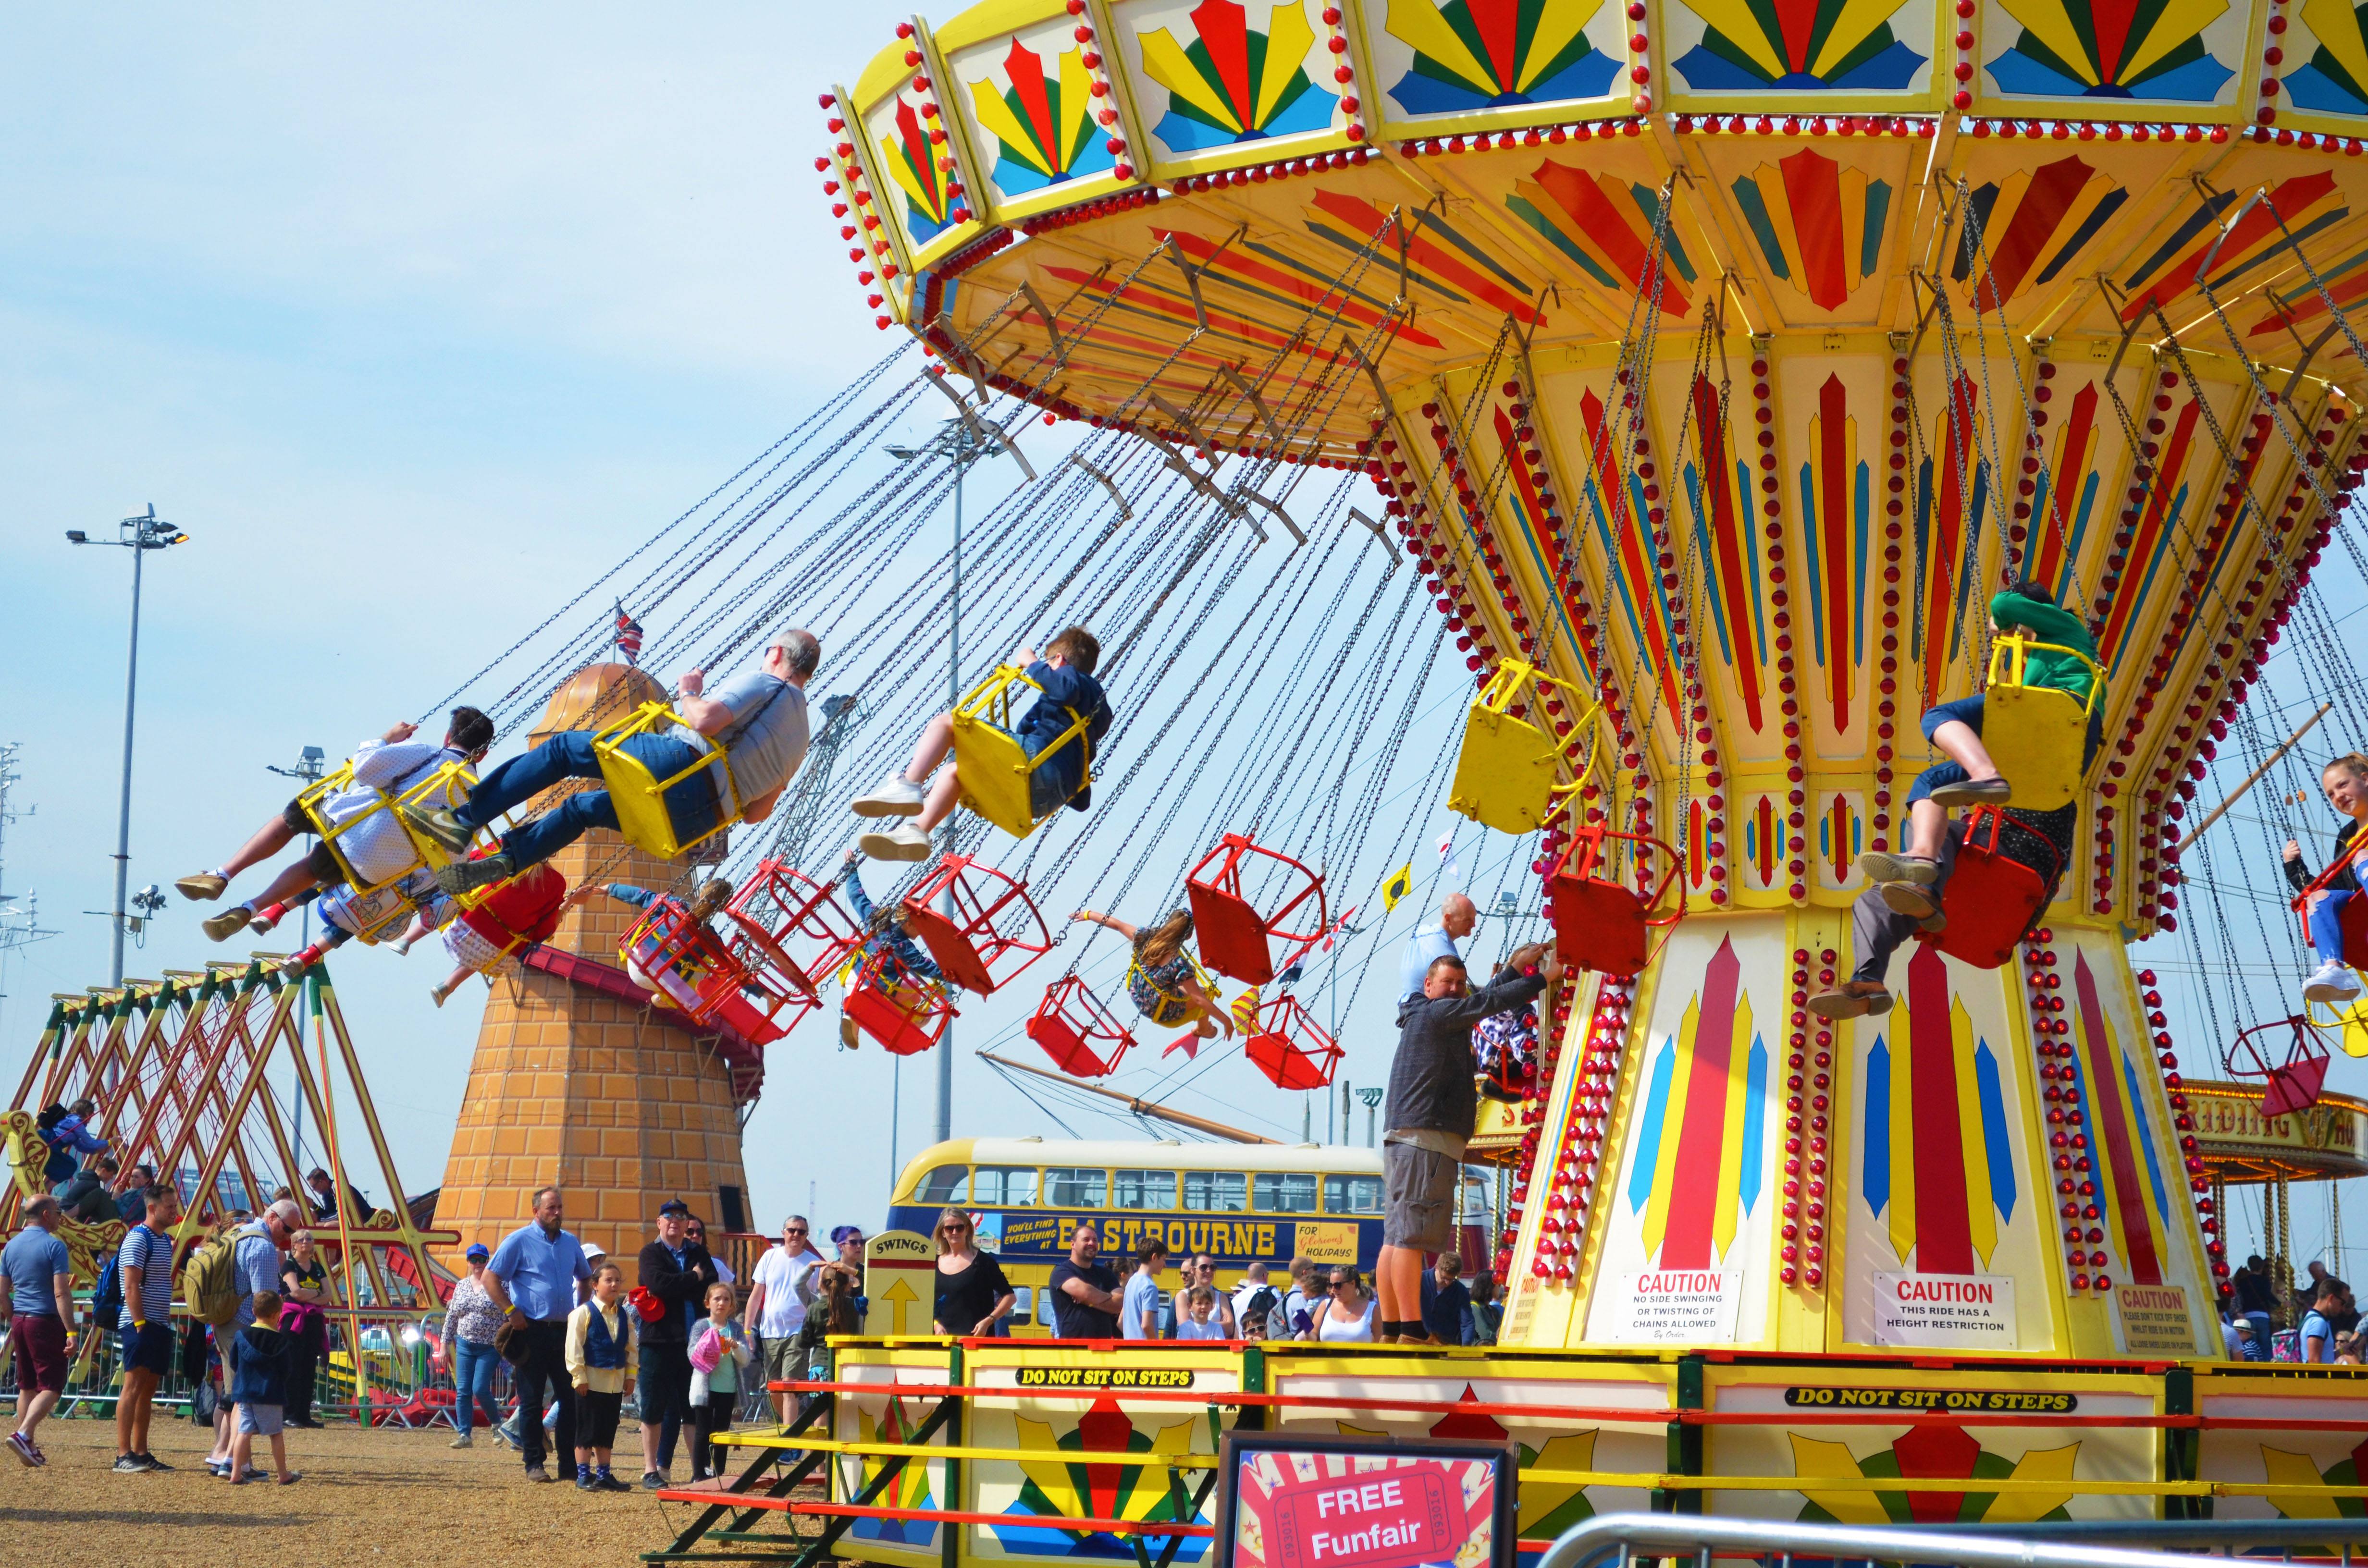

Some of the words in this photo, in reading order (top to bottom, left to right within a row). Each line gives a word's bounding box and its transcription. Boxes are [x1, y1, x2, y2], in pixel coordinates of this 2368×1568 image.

[1007, 1222, 1033, 1234] YOU'LL
[1035, 1219, 1055, 1229] FIND
[1299, 1226, 1318, 1235] FOR
[1004, 1229, 1057, 1245] EVERYTHING
[1297, 1233, 1343, 1251] Glorious
[876, 1238, 928, 1254] SWINGS
[1040, 1240, 1051, 1250] AT
[1306, 1248, 1352, 1257] HOLIDAYS
[1638, 1274, 1721, 1293] CAUTION
[1898, 1280, 1993, 1303] CAUTION
[2122, 1290, 2183, 1310] CAUTION
[1900, 1306, 1925, 1314] THIS
[1929, 1307, 1954, 1315] RIDE
[2123, 1311, 2140, 1320] PLEASE
[2140, 1312, 2153, 1321] DON'T
[2154, 1313, 2164, 1321] KICK
[2165, 1313, 2173, 1322] OFF
[2173, 1314, 2188, 1323] SHOES
[1887, 1319, 1928, 1328] HEIGHT
[1932, 1321, 2004, 1331] RESTRICTION
[2131, 1324, 2147, 1334] WHILST
[2148, 1325, 2158, 1334] RIDE
[2169, 1326, 2185, 1335] MOTION
[1654, 1330, 1663, 1339] By
[1022, 1370, 1045, 1384] DO
[1048, 1371, 1081, 1384] NOT
[1083, 1371, 1109, 1384] SIT
[1113, 1371, 1136, 1385] ON
[1139, 1372, 1189, 1385] STEPS
[1796, 1389, 1834, 1404] DO
[1839, 1390, 1894, 1405] NOT
[1898, 1391, 1940, 1407] SIT
[1946, 1393, 1985, 1408] ON
[1989, 1394, 2069, 1410] STEPS
[1317, 1481, 1403, 1519] FREE
[1312, 1519, 1420, 1560] Funfair
